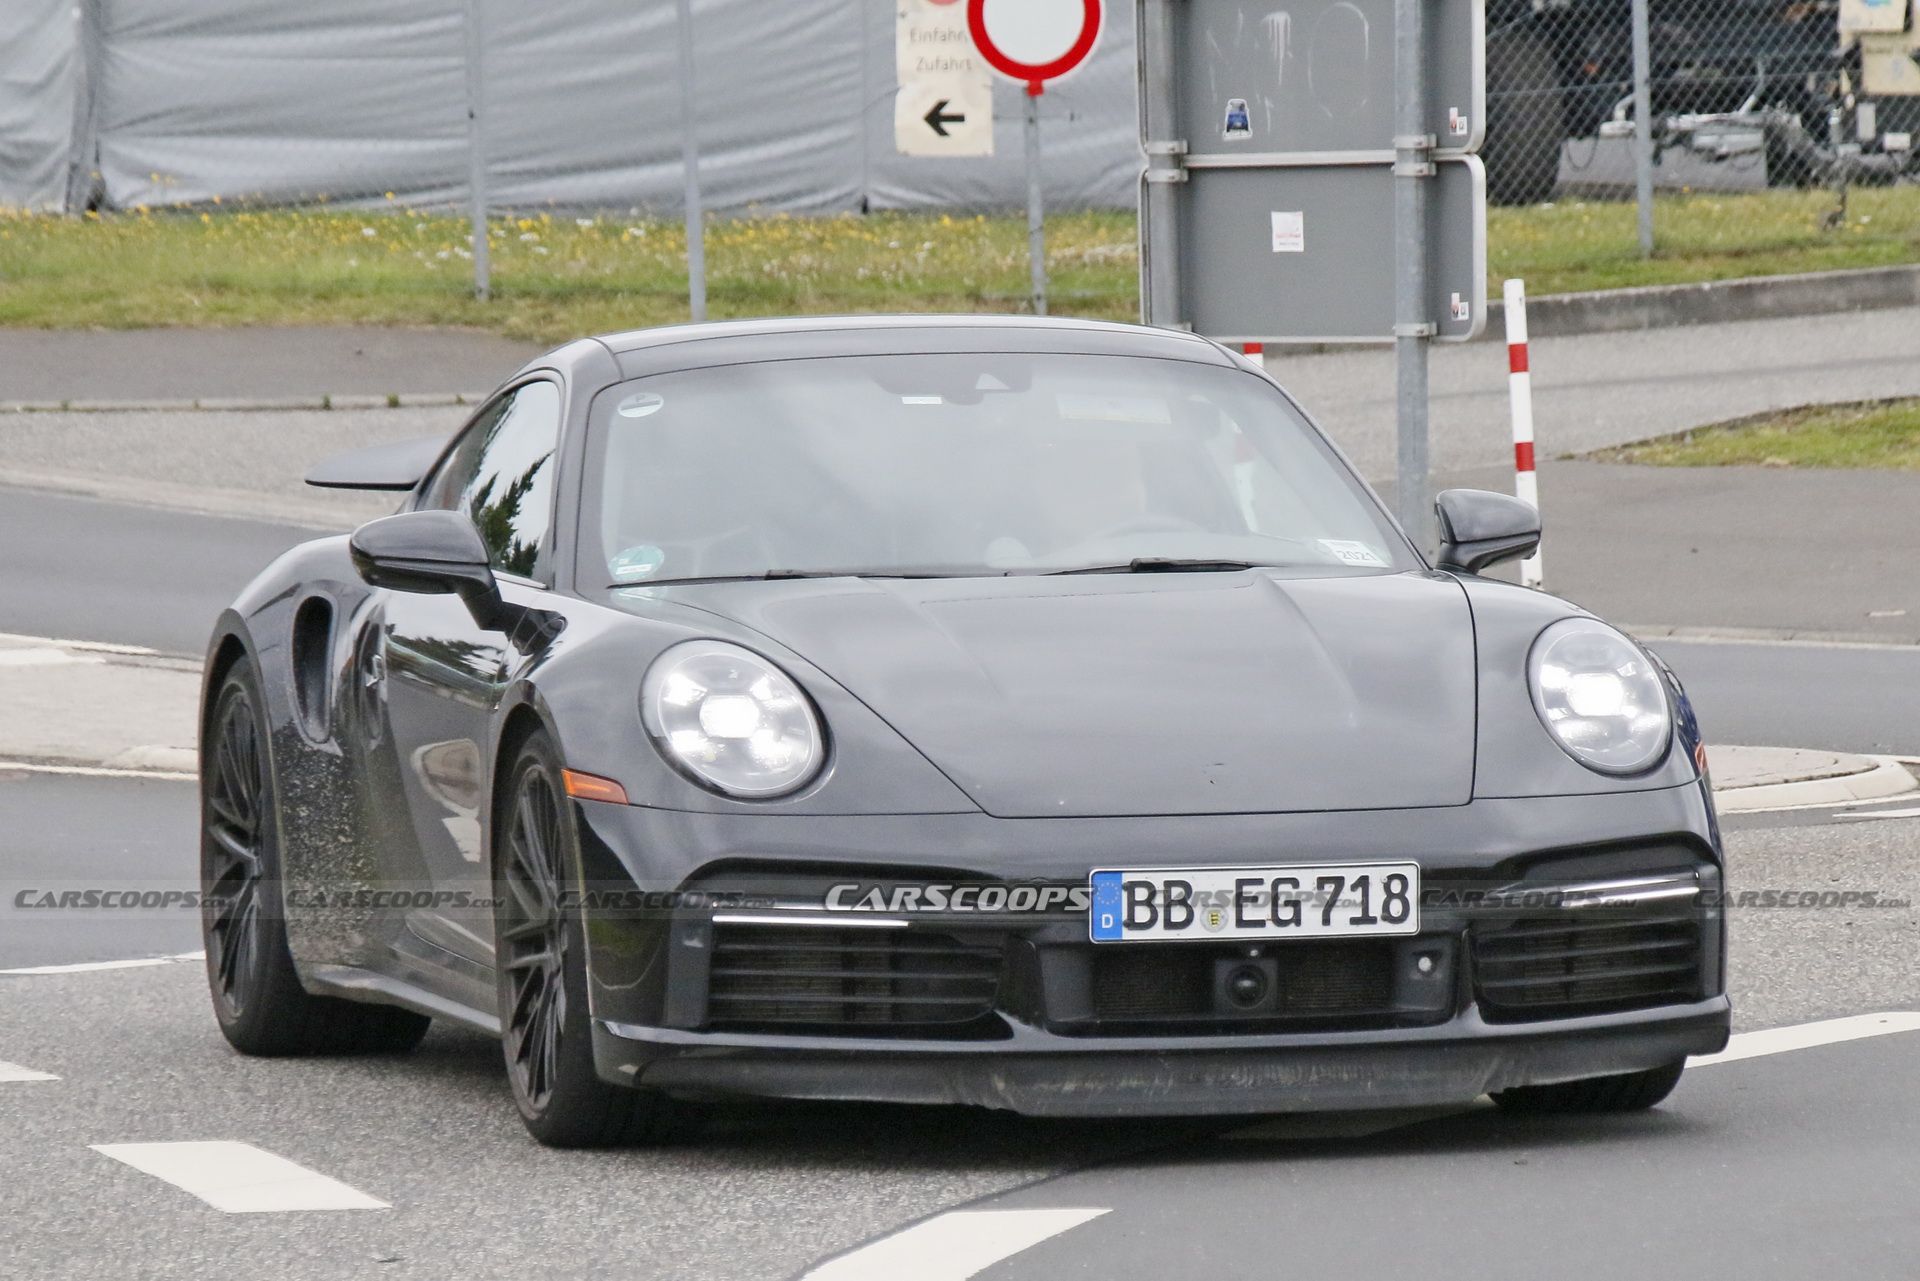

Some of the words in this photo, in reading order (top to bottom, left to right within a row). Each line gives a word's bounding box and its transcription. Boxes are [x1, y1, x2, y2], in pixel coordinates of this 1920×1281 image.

[916, 55, 973, 71] Zufahrt
[1336, 550, 1378, 561] 2021
[1122, 879, 1195, 931] BB
[1235, 877, 1303, 929] EG
[1316, 873, 1410, 927] 718
[1101, 913, 1114, 929] D
